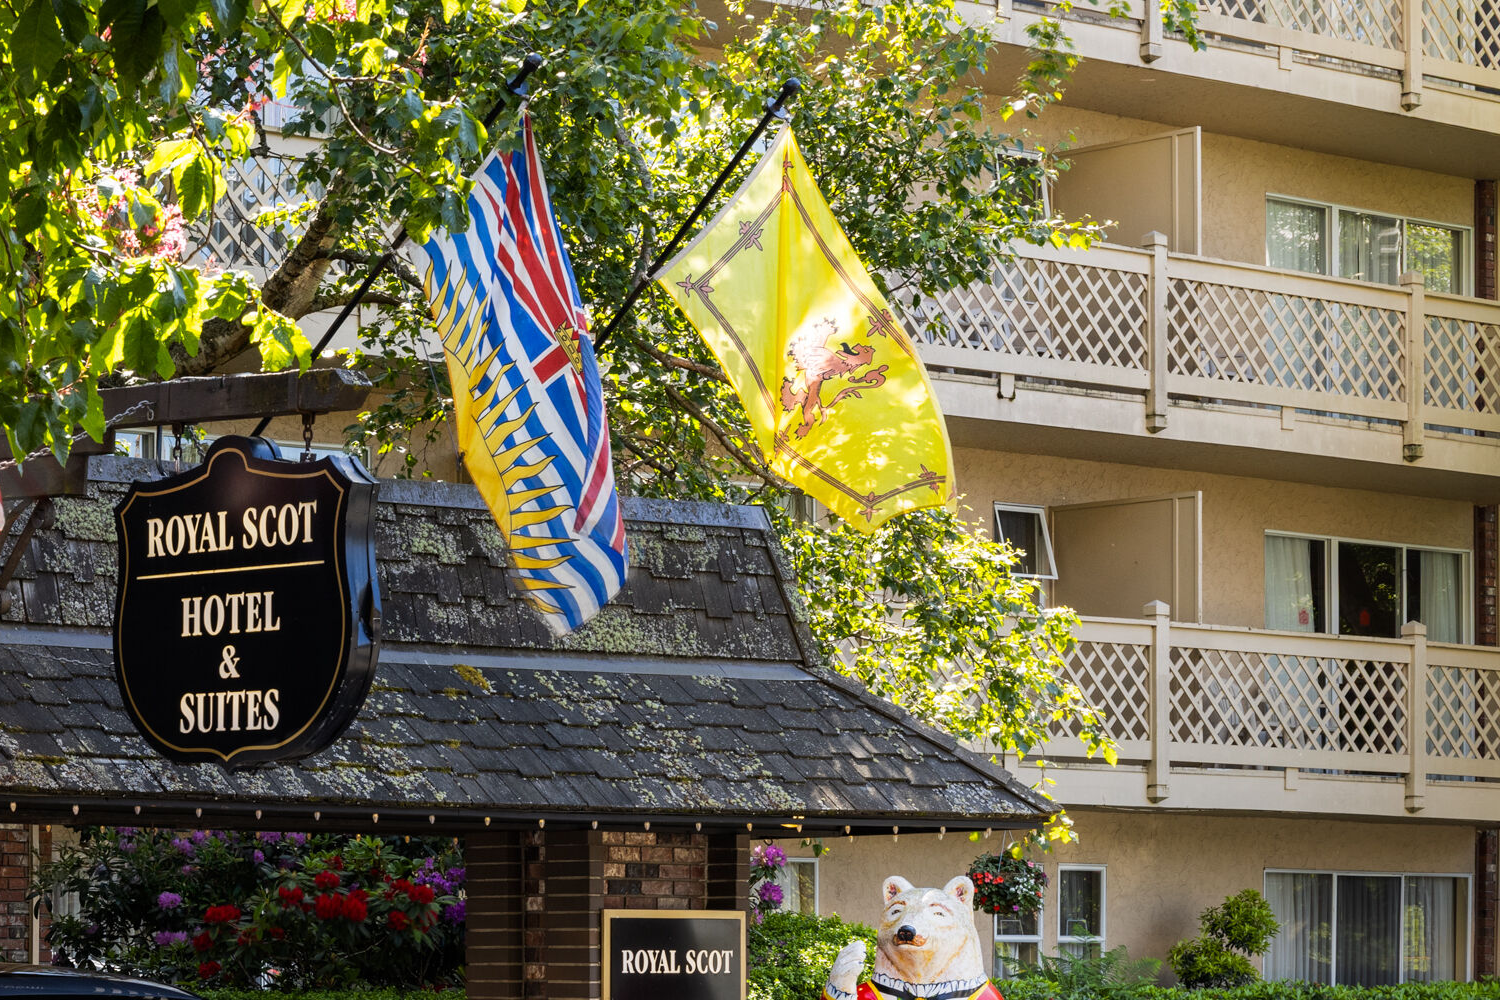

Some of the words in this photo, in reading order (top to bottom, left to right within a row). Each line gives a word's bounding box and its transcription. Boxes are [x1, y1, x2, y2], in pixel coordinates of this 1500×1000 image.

[147, 511, 233, 557] ROYAL
[243, 500, 316, 549] SCOT
[181, 591, 280, 637] HOTEL
[219, 645, 240, 678] &
[180, 689, 279, 733] SUITES
[622, 950, 680, 974] ROYAL
[686, 950, 733, 974] SCOT
